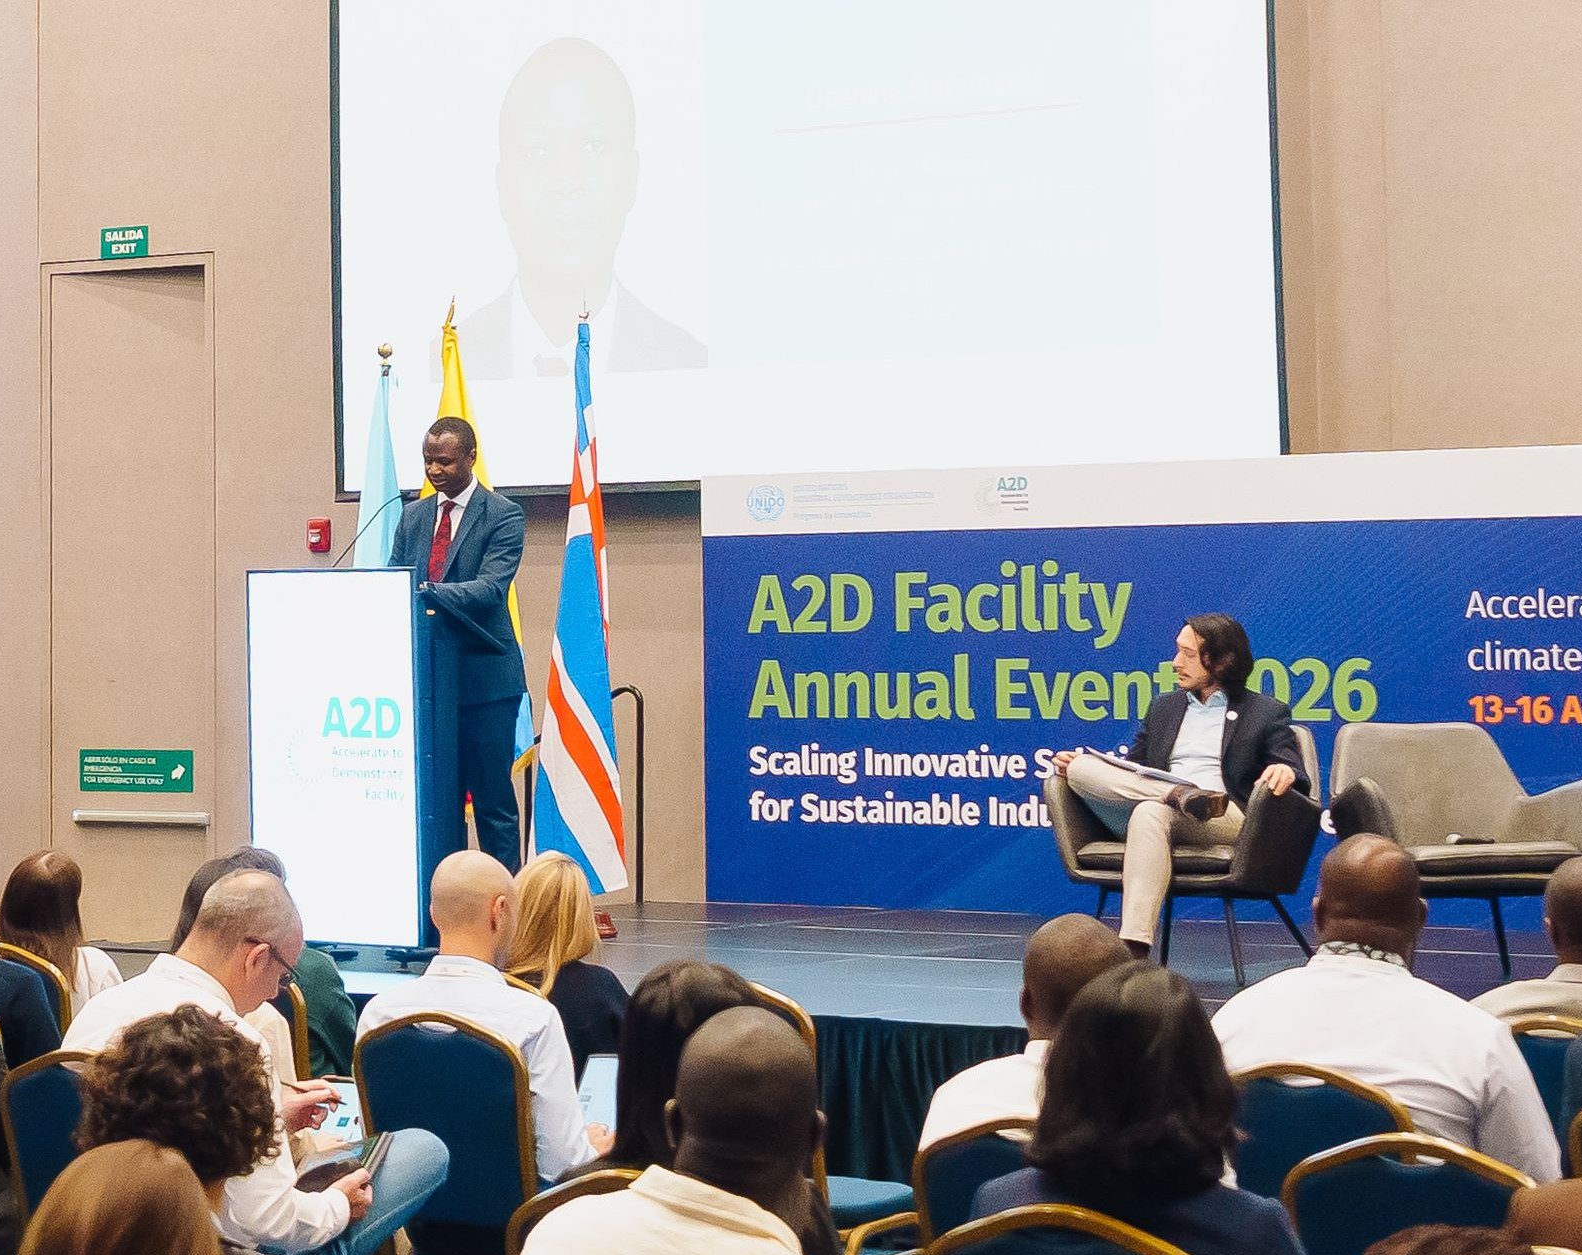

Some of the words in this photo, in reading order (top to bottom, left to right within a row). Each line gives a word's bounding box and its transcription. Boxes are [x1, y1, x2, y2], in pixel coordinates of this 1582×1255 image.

[105, 229, 144, 242] SALIDA
[111, 243, 137, 255] EXIT
[996, 476, 1028, 492] A2D
[746, 496, 786, 508] UNIDO
[747, 573, 874, 633] A2D
[894, 559, 1133, 650] Facility
[747, 653, 976, 721] Annual
[995, 657, 1180, 721] Event
[1245, 657, 1378, 722] 026
[1467, 694, 1554, 724] 13-16
[322, 696, 401, 739] A2D
[331, 746, 389, 759] Accelerate
[392, 748, 404, 759] to
[748, 742, 858, 785] Scaling
[864, 744, 1027, 779] Innovative
[332, 767, 404, 779] Demonstrate
[365, 788, 405, 802] Facility
[748, 790, 794, 822] for
[800, 790, 981, 827] Sustainable
[988, 795, 1053, 828] Indu
